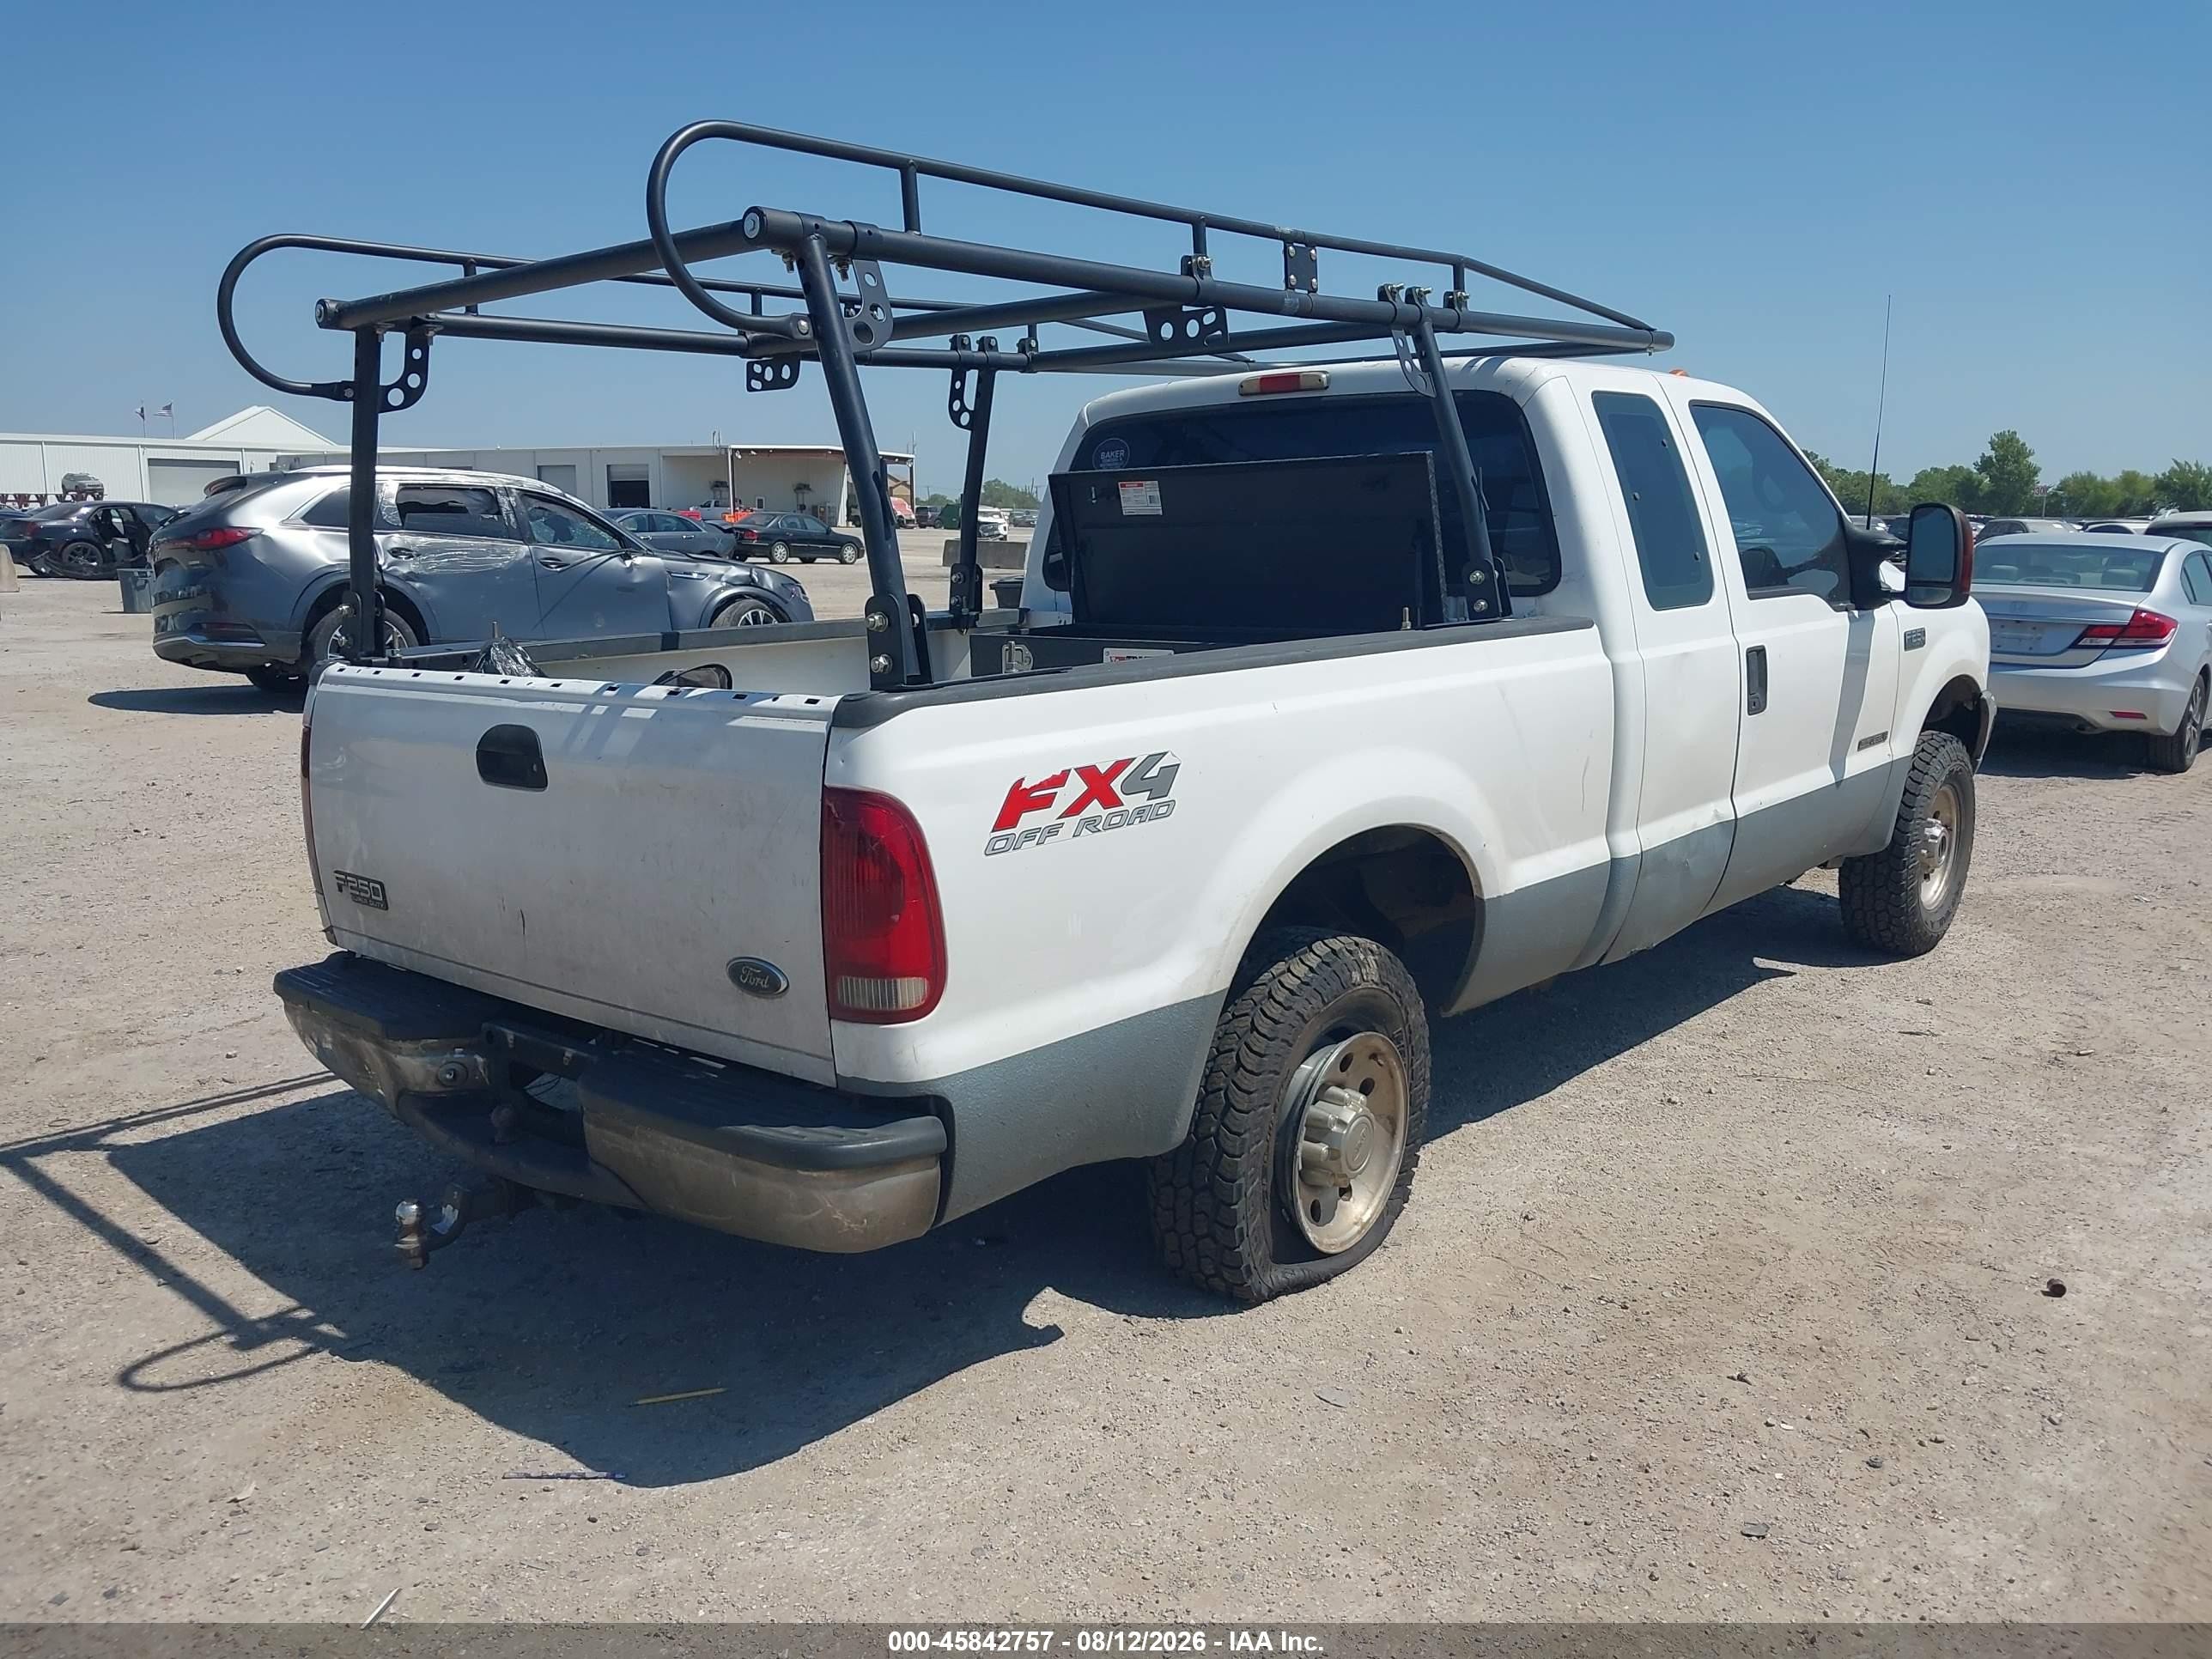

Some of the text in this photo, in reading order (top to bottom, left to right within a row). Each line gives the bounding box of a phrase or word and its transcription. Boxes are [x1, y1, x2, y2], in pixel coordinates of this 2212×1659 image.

[1100, 449, 1125, 459] BAKER
[991, 751, 1181, 832] FX4
[984, 799, 1176, 856] OFF ROAD
[739, 965, 770, 988] Ford
